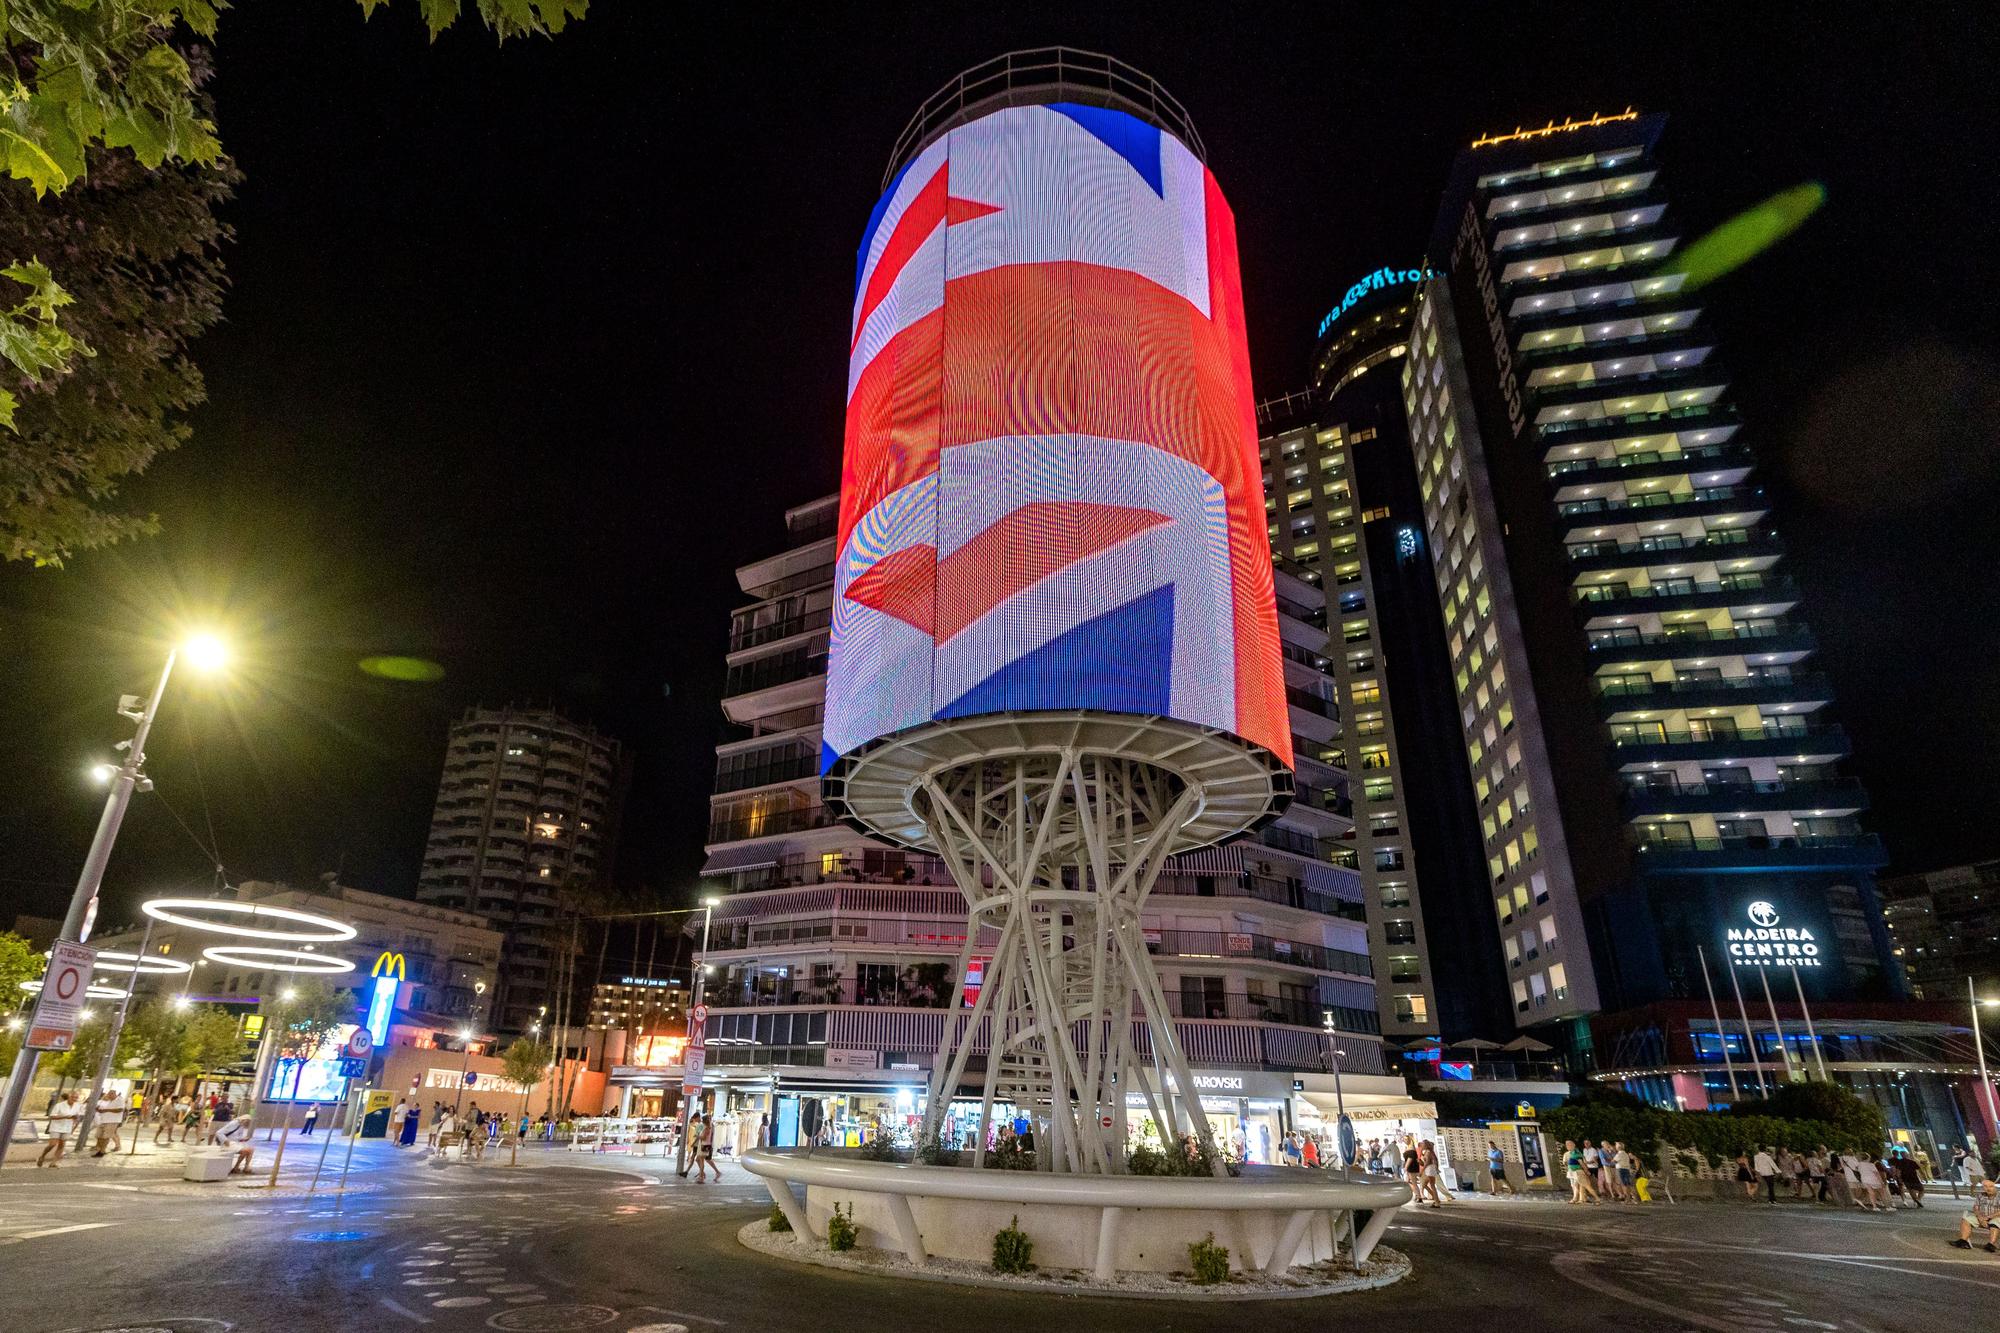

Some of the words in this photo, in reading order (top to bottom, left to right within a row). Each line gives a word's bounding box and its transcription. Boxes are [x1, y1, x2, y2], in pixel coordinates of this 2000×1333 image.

[1727, 928, 1815, 941] MADEIRA
[1729, 943, 1818, 956] CENTRO
[1775, 958, 1822, 966] HOTEL
[355, 1036, 368, 1048] 10
[1520, 1126, 1536, 1134] ATM
